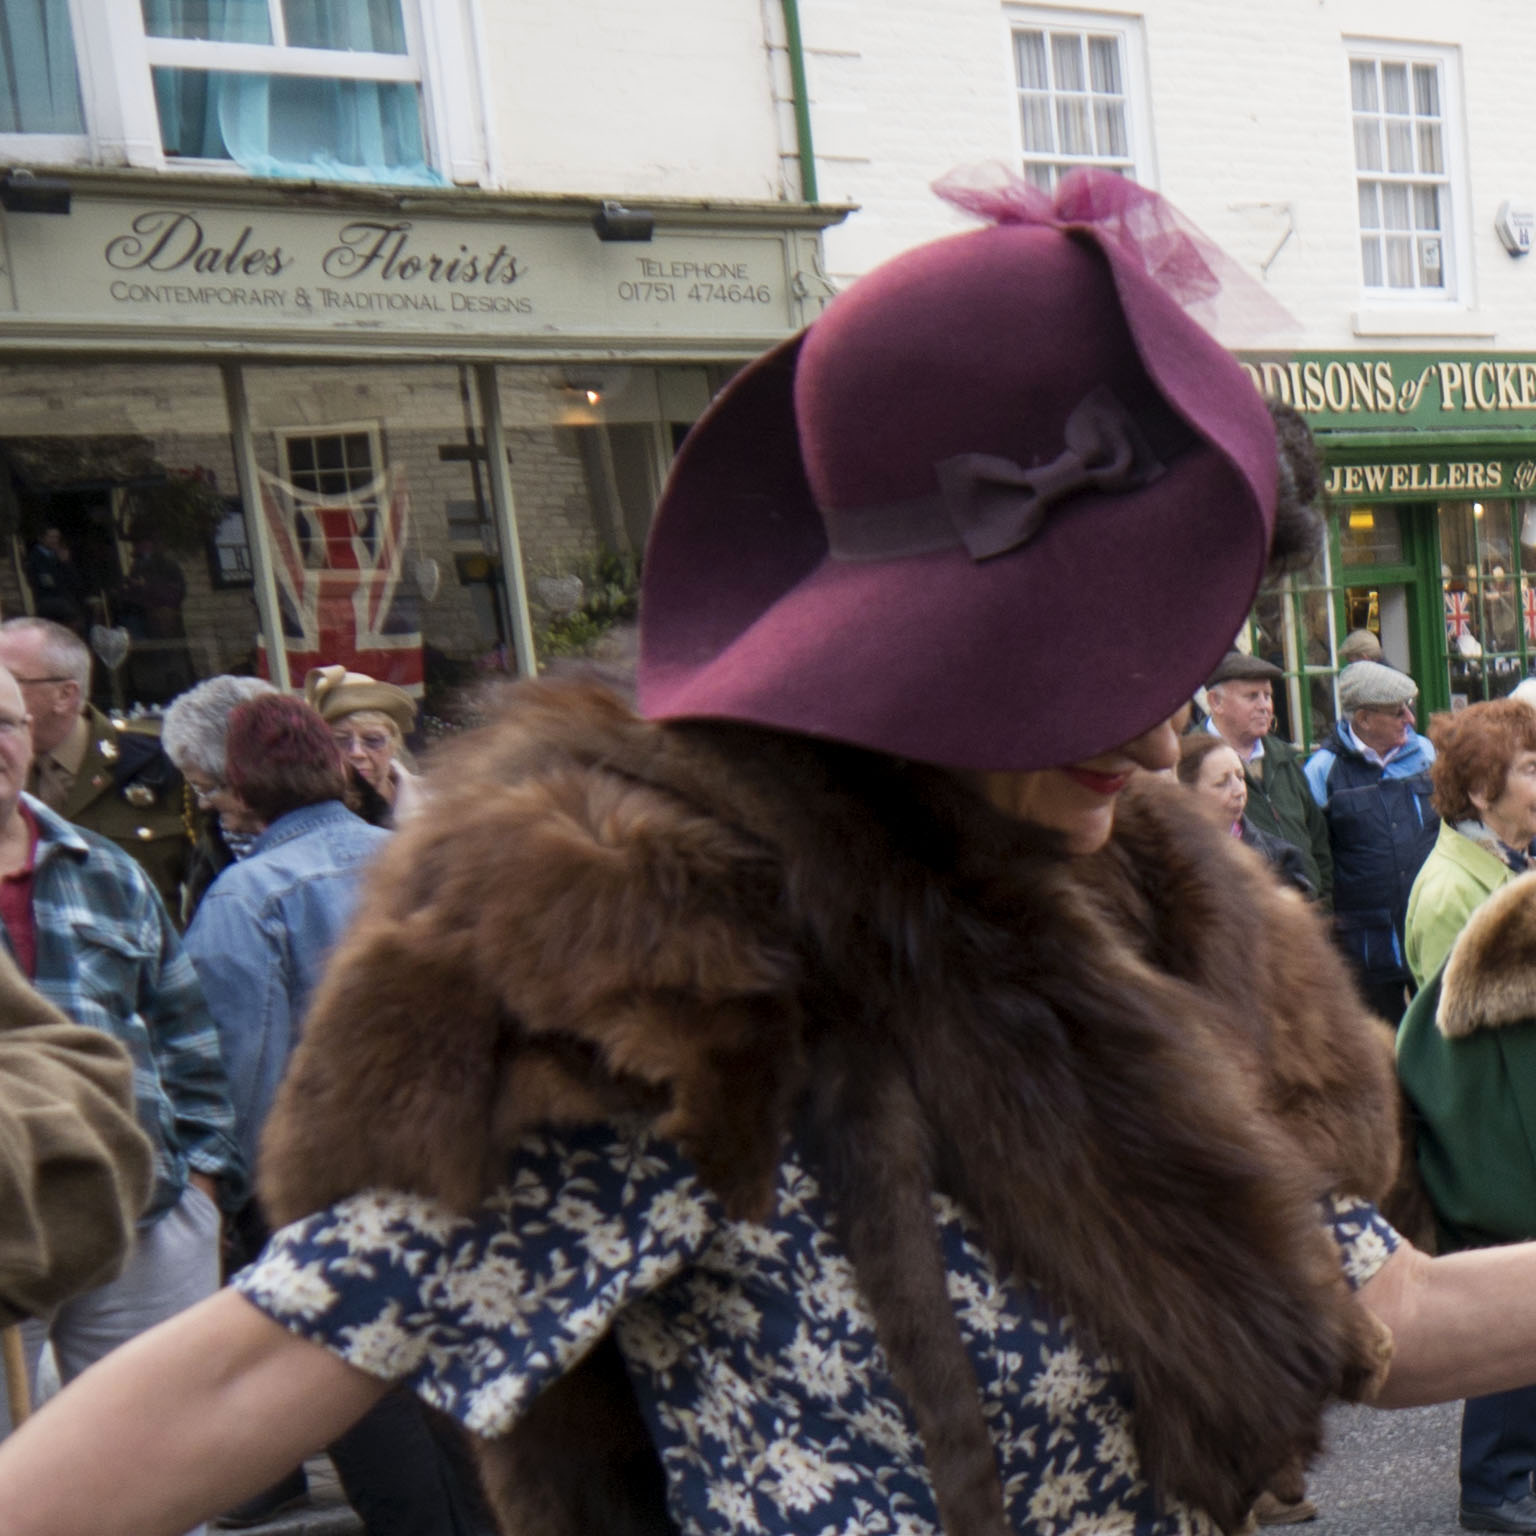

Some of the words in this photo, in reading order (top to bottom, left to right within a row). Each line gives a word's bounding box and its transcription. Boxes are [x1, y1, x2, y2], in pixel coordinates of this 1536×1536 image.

[104, 209, 295, 276] Dales
[322, 221, 529, 285] Florists
[636, 256, 749, 280] TELEPHONE
[109, 280, 287, 308] CONTEMPORARY
[295, 289, 311, 310] &
[317, 287, 445, 313] TRADITIONAL
[450, 291, 532, 315] DESIGNS
[617, 280, 676, 302] 01751
[687, 283, 772, 304] 474646
[1399, 366, 1437, 414] of
[1326, 461, 1503, 494] JEWELLERS
